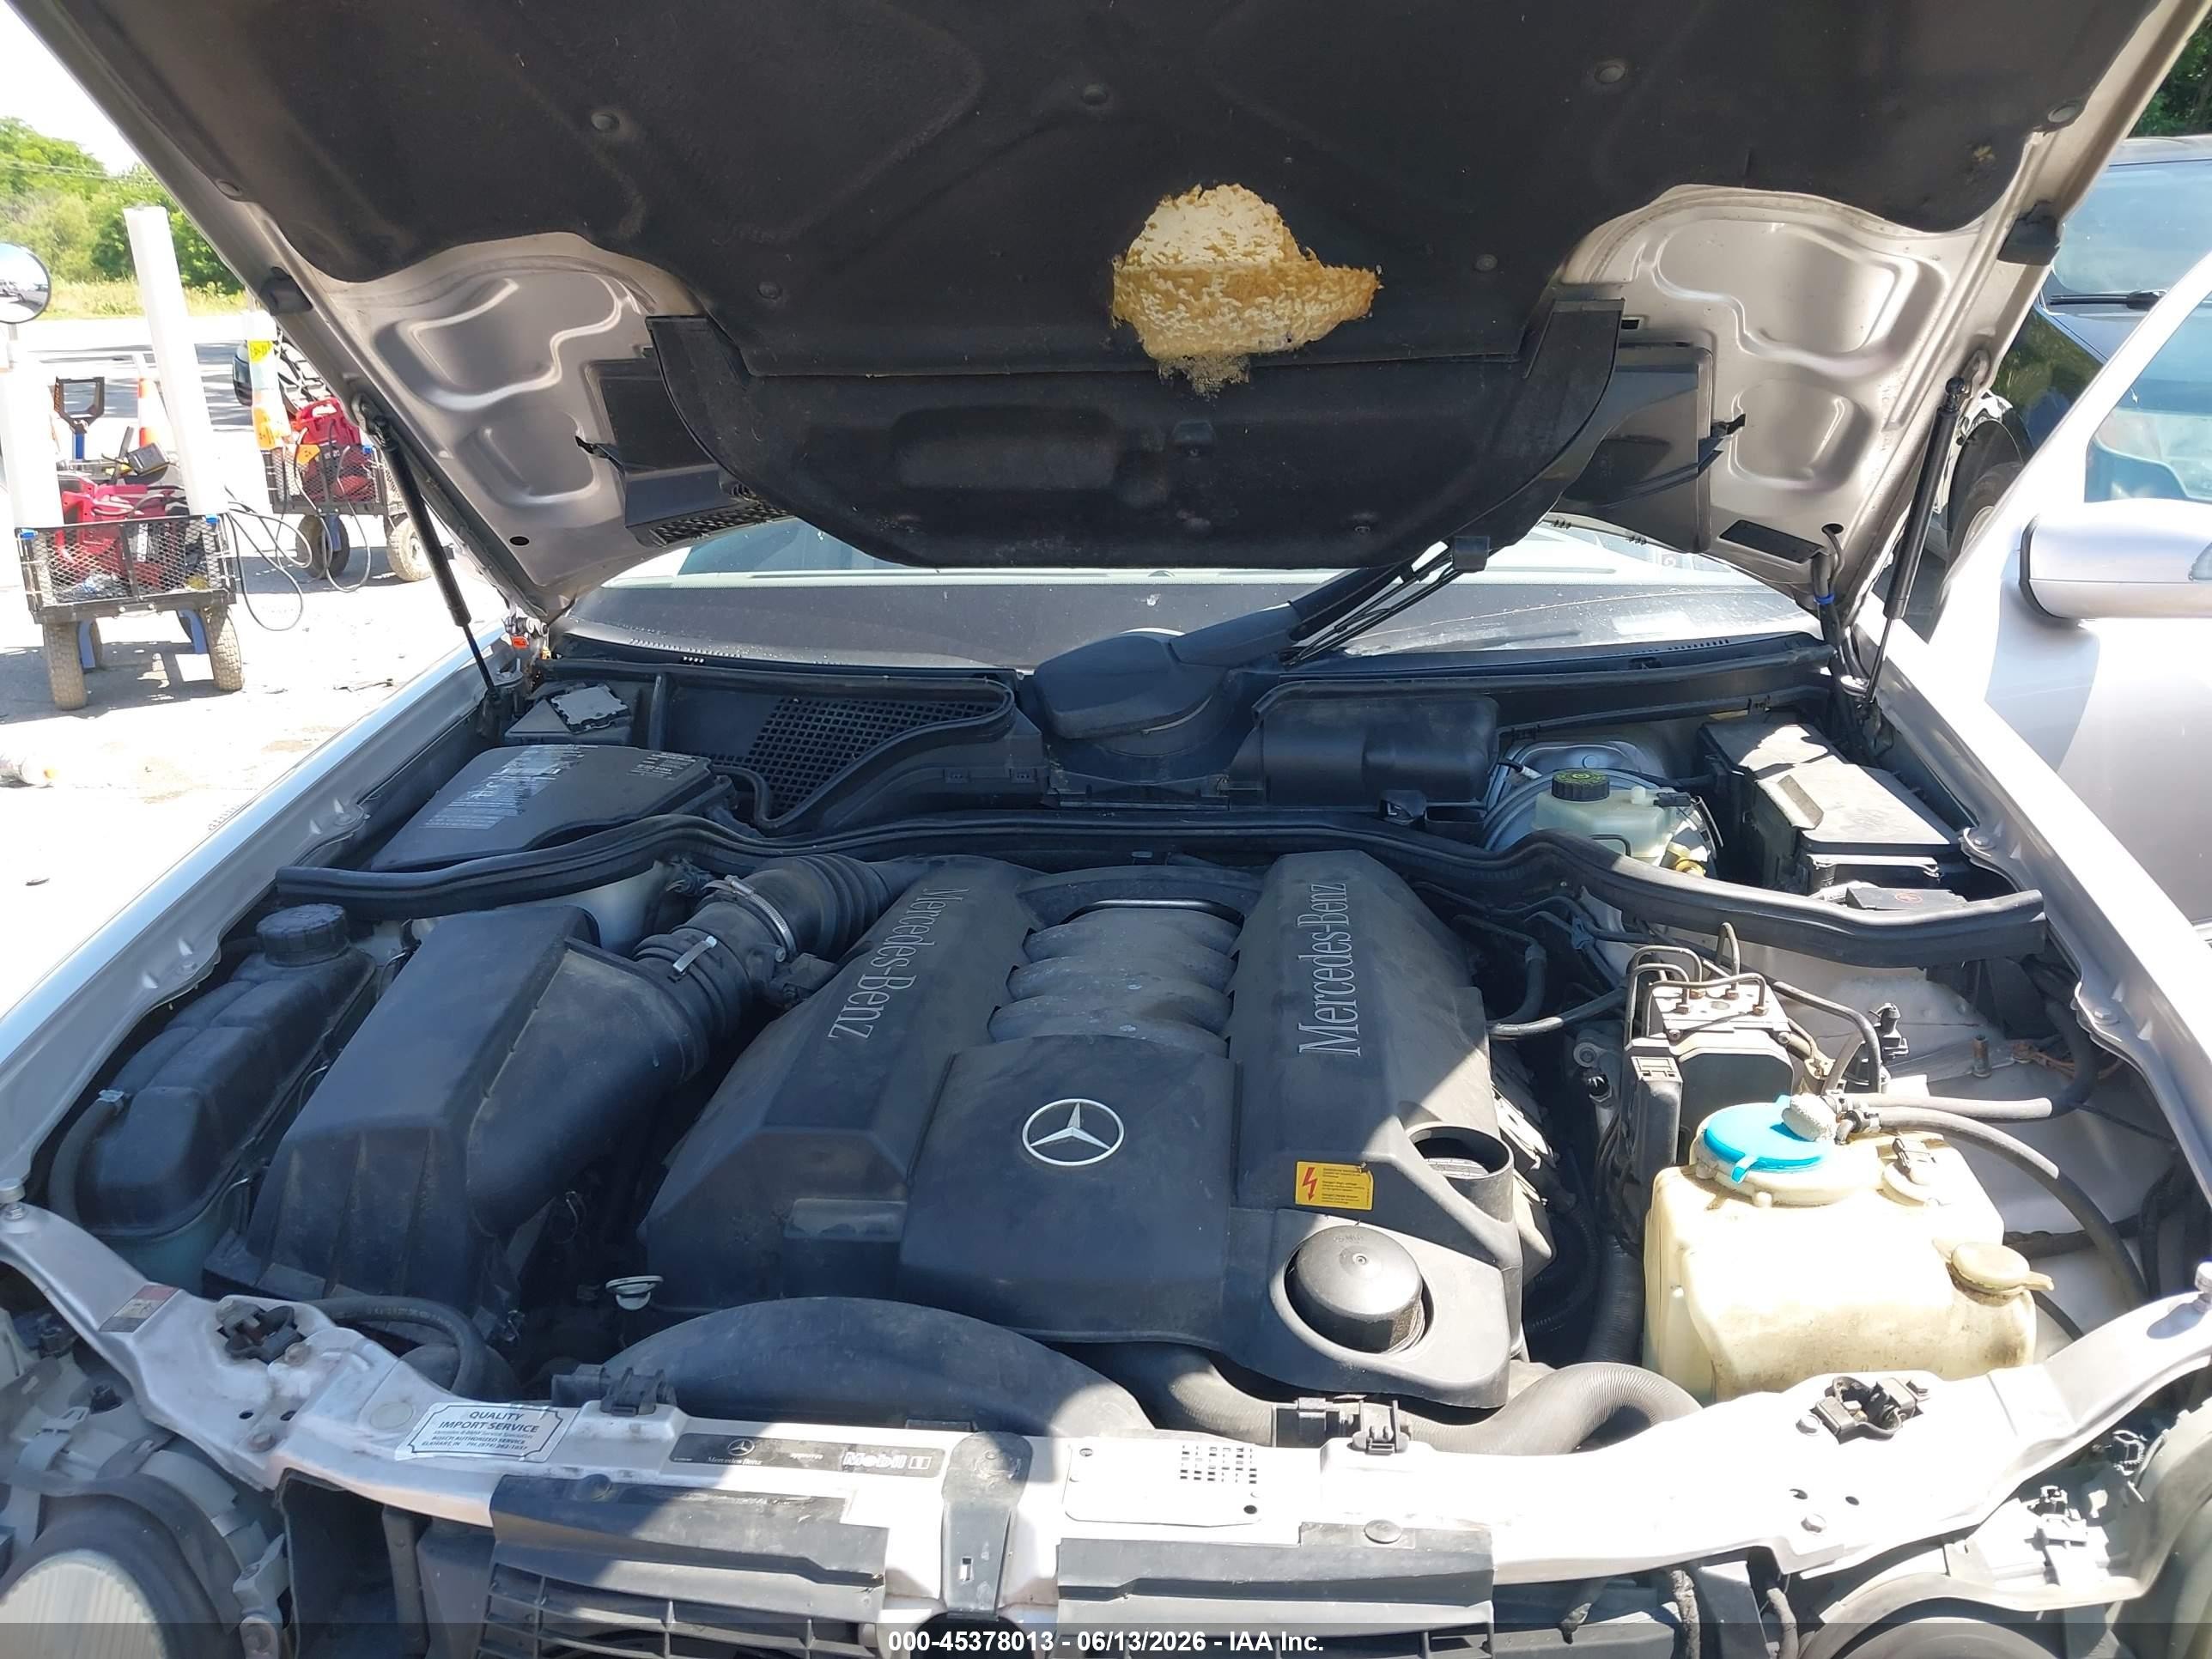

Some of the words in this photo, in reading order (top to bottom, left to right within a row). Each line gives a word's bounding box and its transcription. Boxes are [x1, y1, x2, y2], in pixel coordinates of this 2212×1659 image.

[828, 888, 969, 1038] Mercedes-Benz
[1297, 883, 1361, 1056] Mercedes-Benz
[469, 1411, 525, 1420] QUALITY
[439, 1421, 489, 1430] IMPORT
[487, 1422, 540, 1432] SERVICE
[842, 1451, 908, 1469] Mobil
